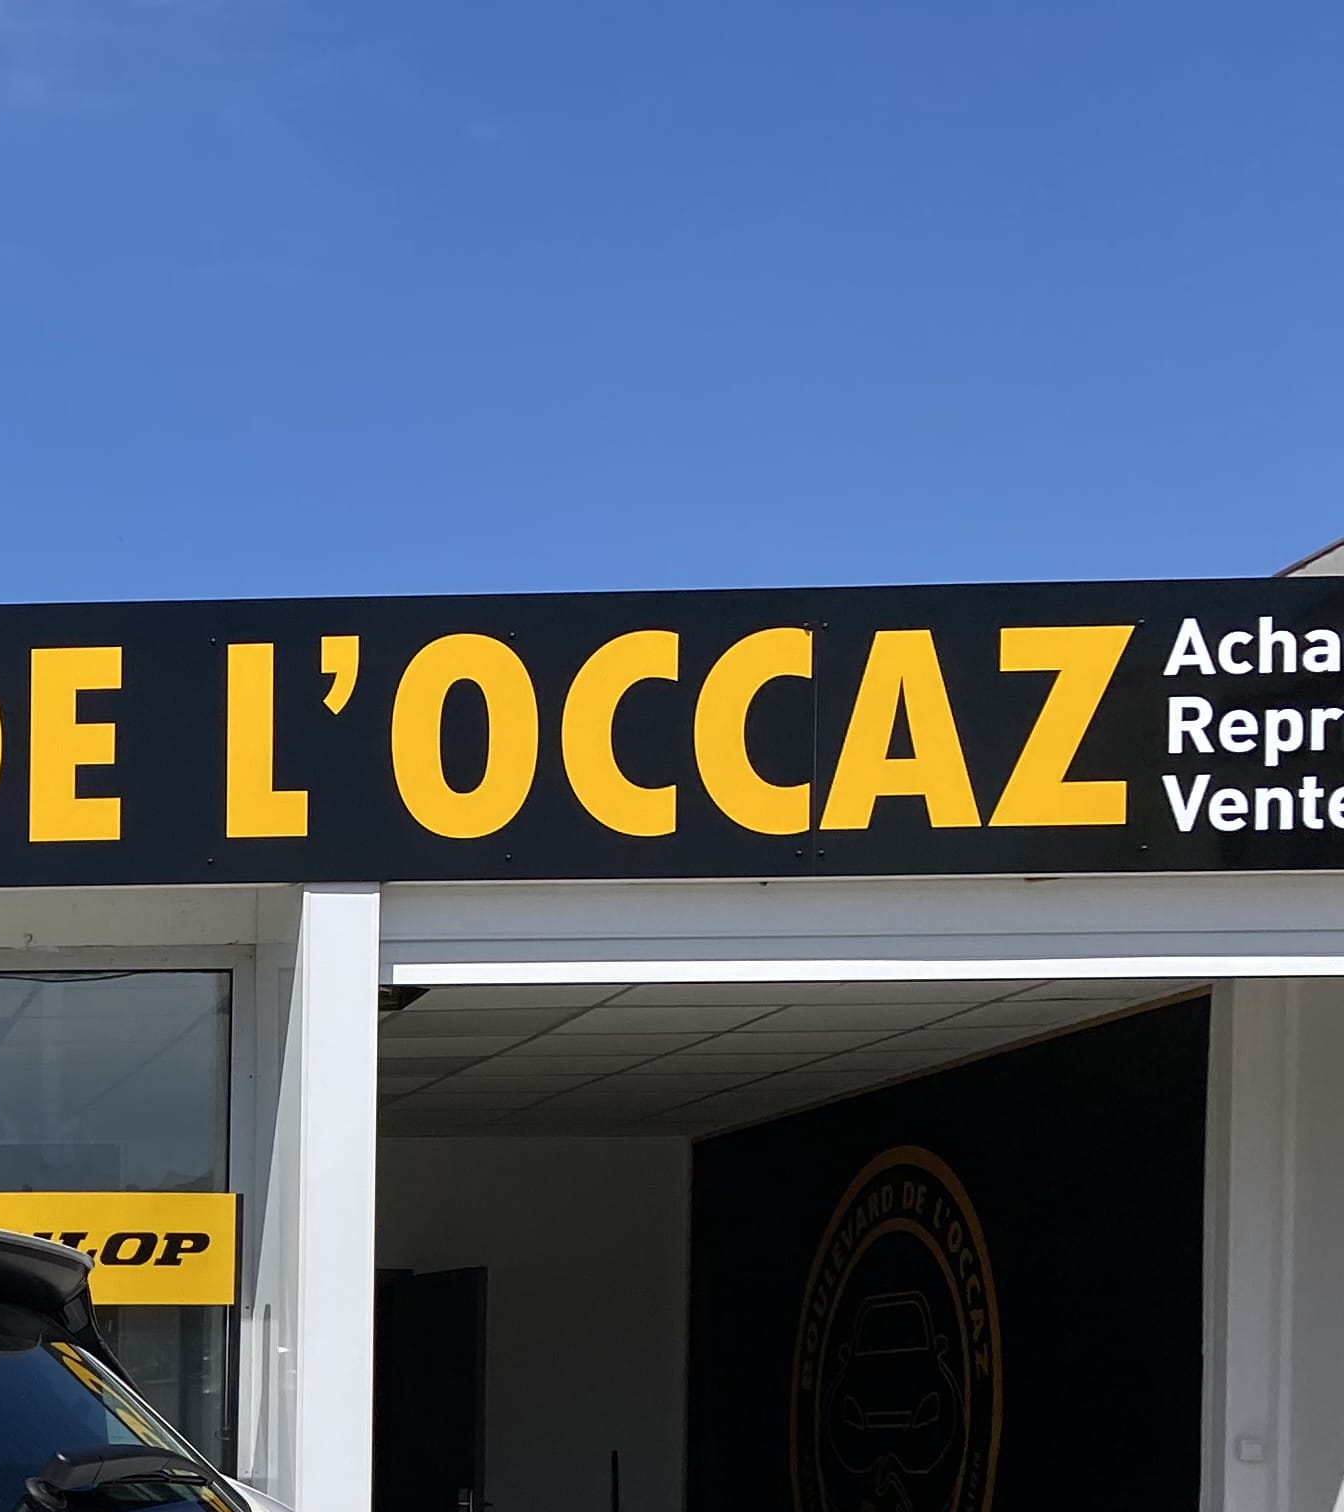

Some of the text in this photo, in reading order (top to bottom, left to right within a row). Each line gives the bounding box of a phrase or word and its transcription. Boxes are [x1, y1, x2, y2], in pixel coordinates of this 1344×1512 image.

[1163, 616, 1341, 676] Acha
[227, 626, 1132, 838] L'OCCAZ
[1167, 696, 1344, 767] Repr
[901, 1179, 928, 1216] DE
